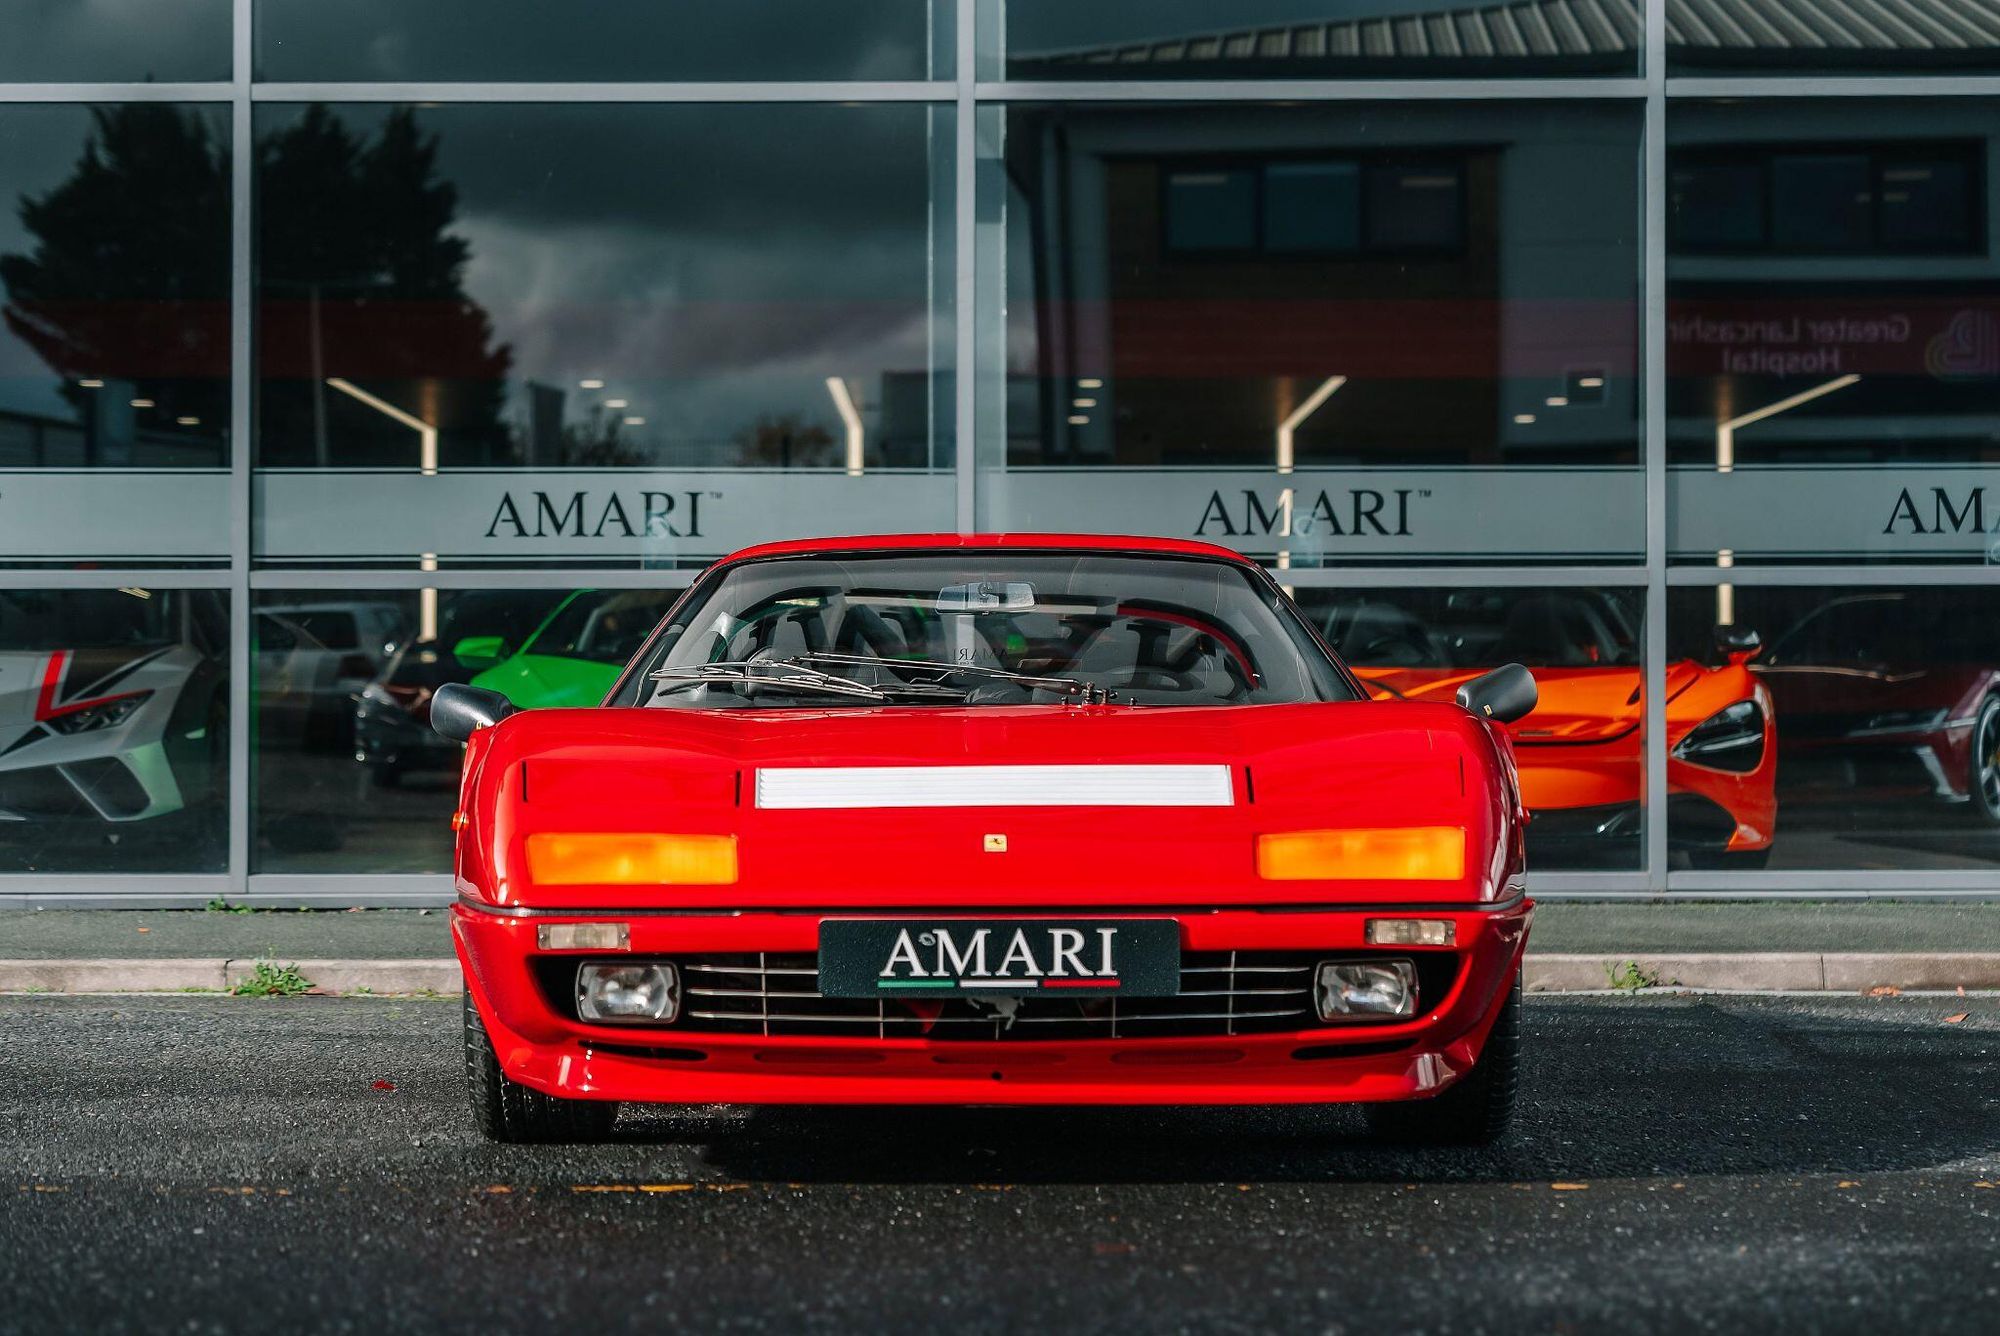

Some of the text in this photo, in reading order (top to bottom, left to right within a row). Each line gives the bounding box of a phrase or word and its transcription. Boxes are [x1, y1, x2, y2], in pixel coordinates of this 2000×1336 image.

[484, 491, 704, 537] AMARI
[1882, 487, 2000, 534] AM
[879, 928, 1118, 977] AMARI
